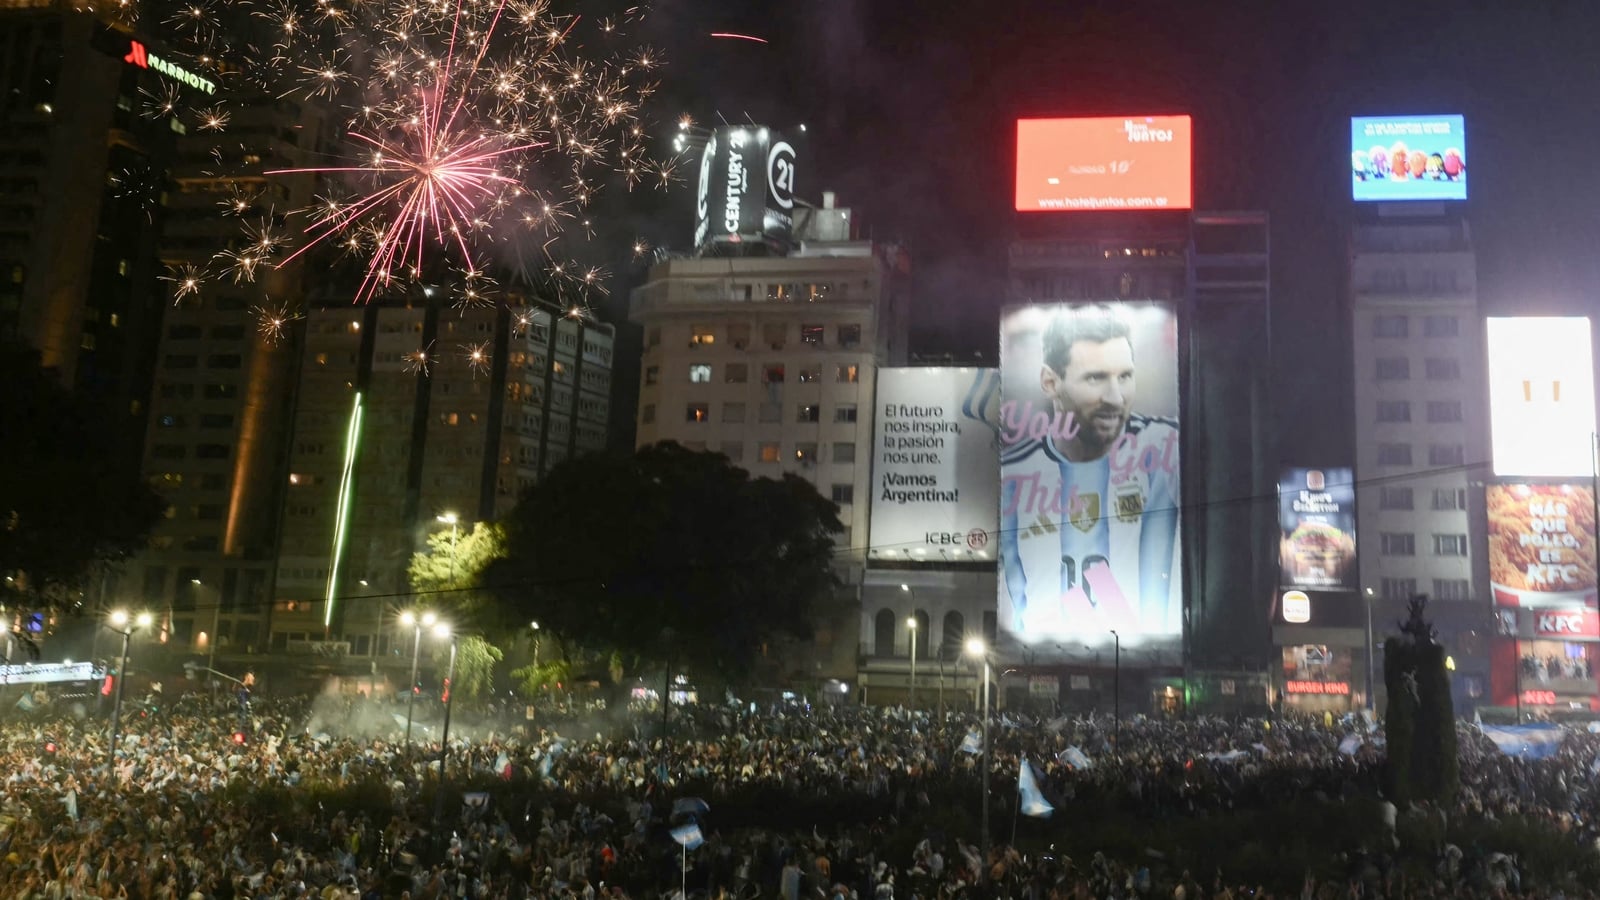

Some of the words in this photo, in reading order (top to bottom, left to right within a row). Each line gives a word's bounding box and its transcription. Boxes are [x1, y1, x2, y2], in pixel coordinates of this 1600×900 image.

[147, 52, 216, 96] MARRIOTT
[724, 149, 743, 233] CENTURY
[885, 403, 897, 418] El
[900, 403, 943, 418] futuro
[884, 421, 910, 433] nos
[912, 420, 962, 436] inspira,
[1001, 399, 1081, 445] You
[883, 435, 895, 449] la
[898, 434, 944, 453] pasión
[883, 451, 909, 464] nos
[911, 451, 942, 465] une.
[1108, 430, 1180, 487] Got
[881, 471, 938, 489] ¡Vamos
[881, 488, 960, 505] Argentina!
[1001, 471, 1083, 517] This
[1531, 518, 1567, 533] QUE
[925, 532, 962, 545] ICBC
[1527, 563, 1579, 585] KFC
[1541, 612, 1584, 633] KFC
[1287, 681, 1323, 695] BURGER
[1324, 682, 1350, 696] KING
[1524, 690, 1556, 705] KFC
